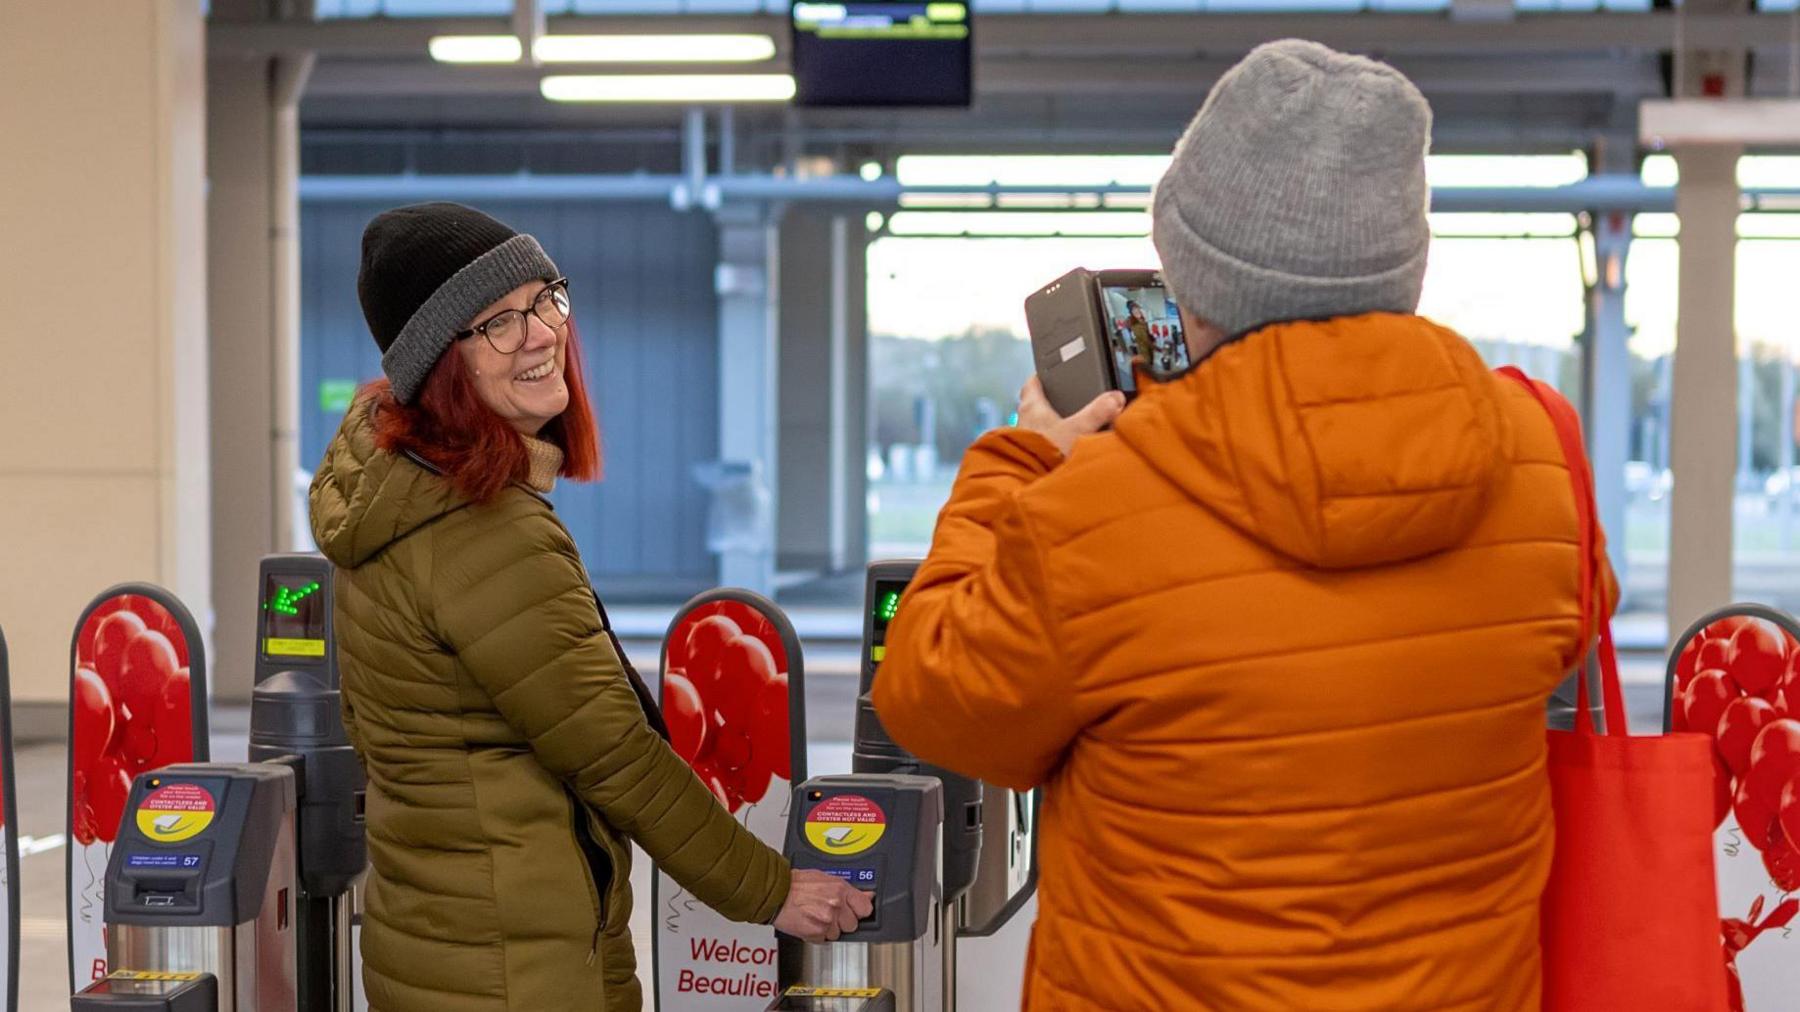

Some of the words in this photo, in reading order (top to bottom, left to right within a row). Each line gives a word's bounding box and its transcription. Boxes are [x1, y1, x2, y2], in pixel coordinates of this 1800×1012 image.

[184, 856, 198, 866] 57
[859, 870, 873, 880] 56
[690, 937, 778, 966] Welco
